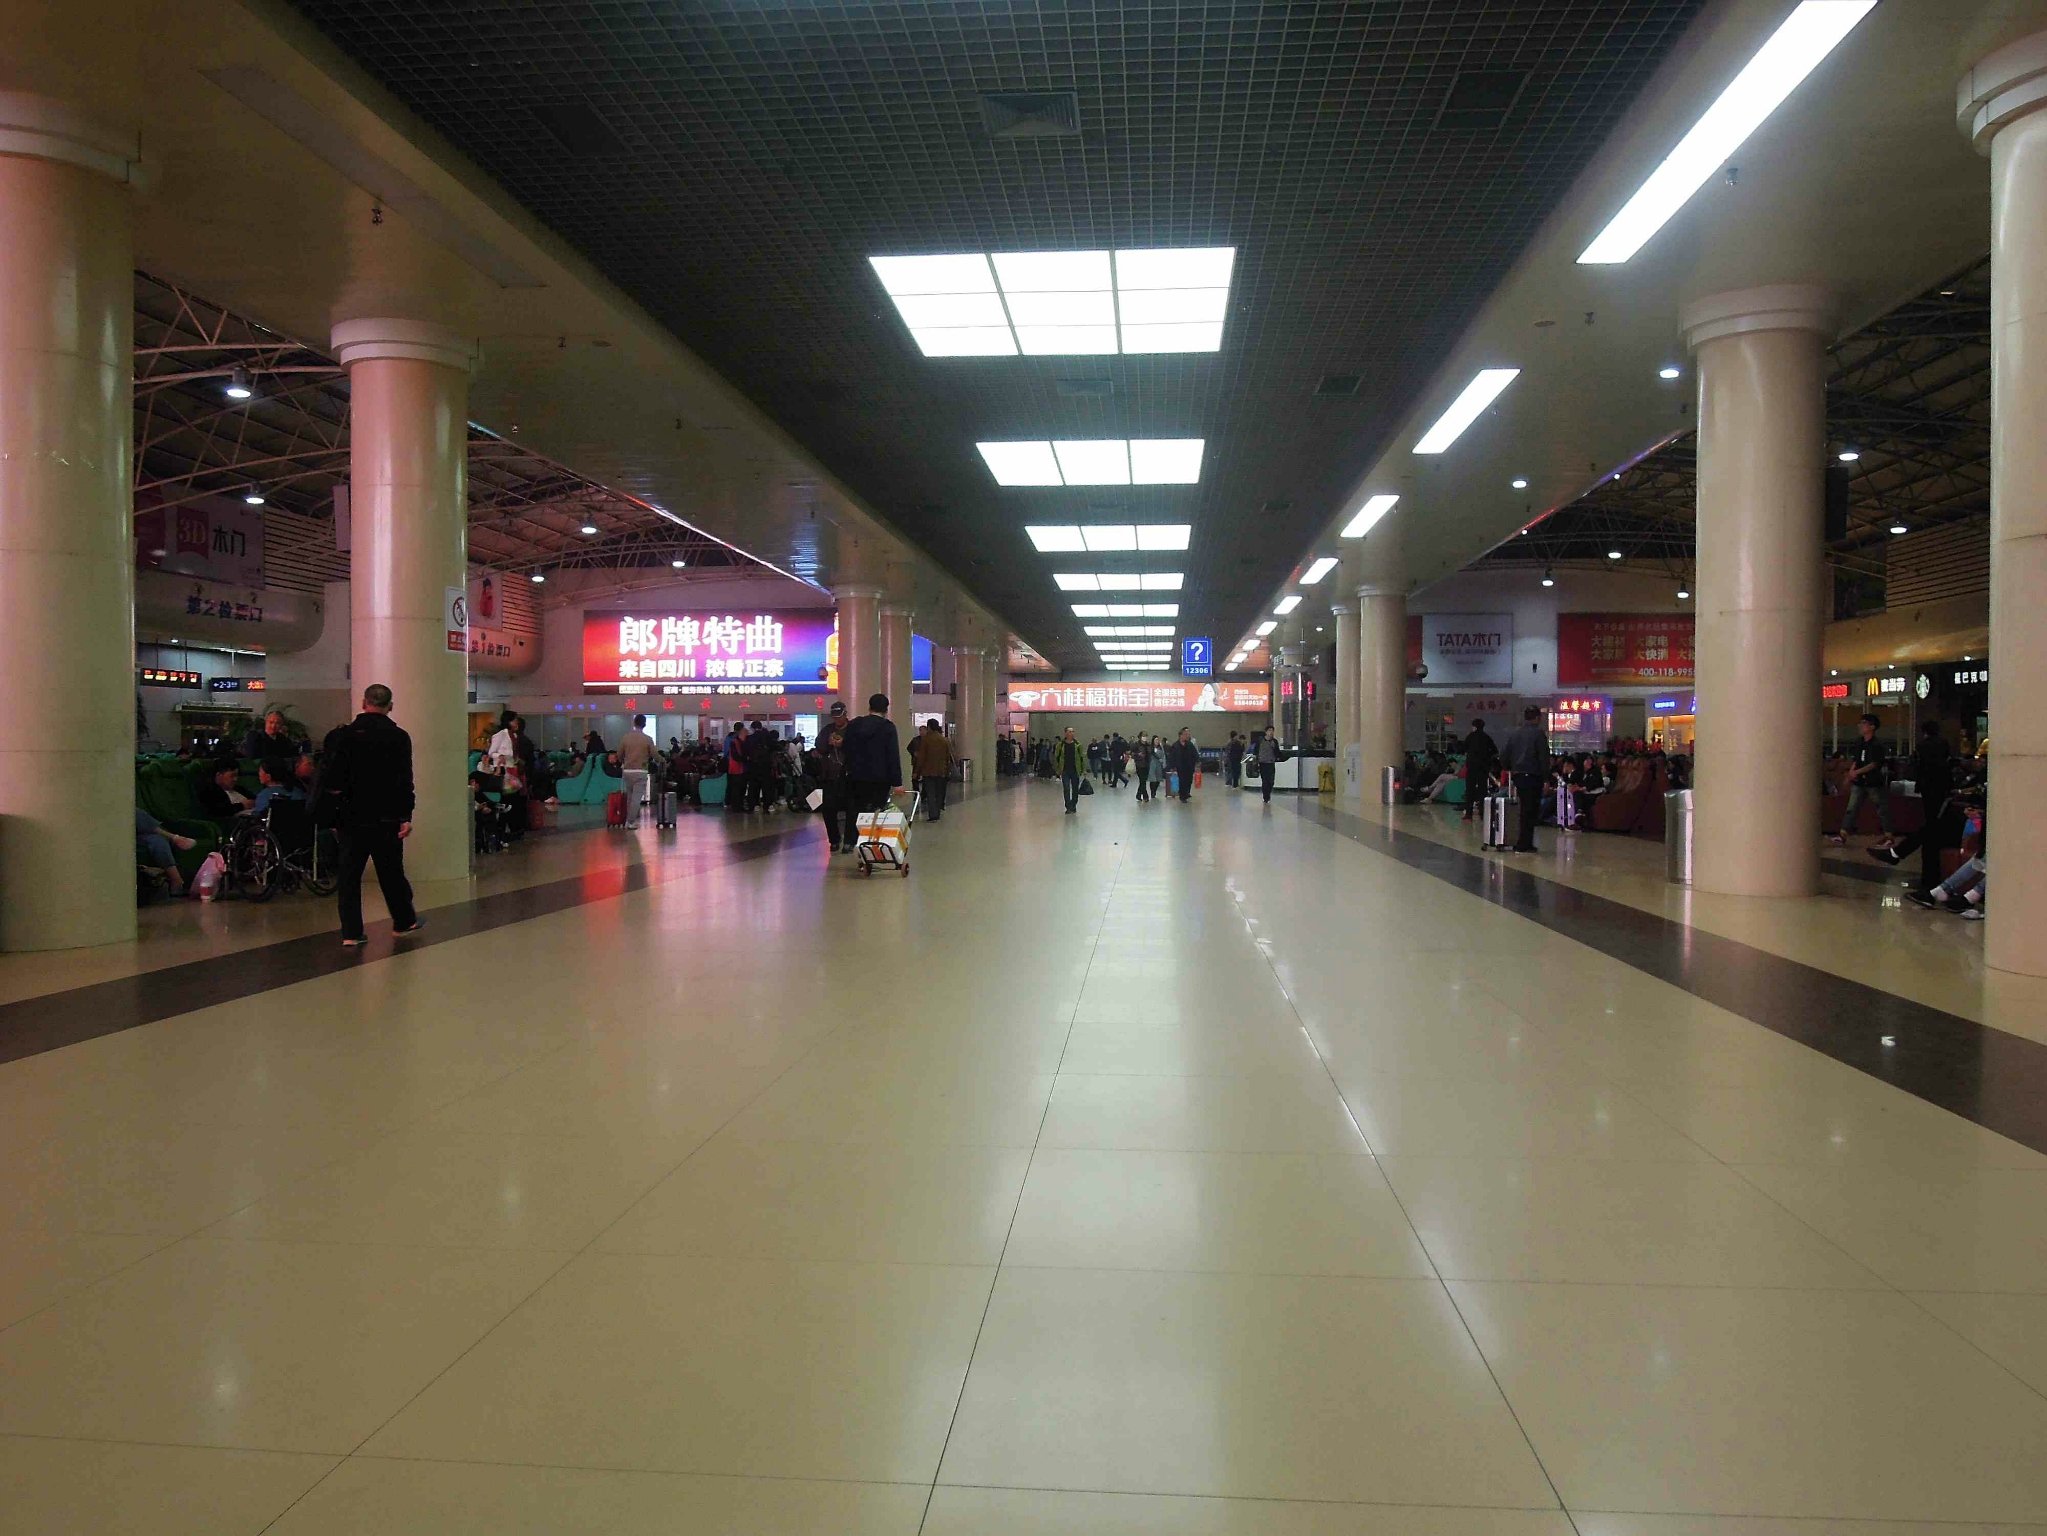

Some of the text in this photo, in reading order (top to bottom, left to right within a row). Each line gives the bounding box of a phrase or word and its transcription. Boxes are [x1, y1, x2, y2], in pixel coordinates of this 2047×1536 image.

[212, 524, 245, 557] 木门
[619, 614, 783, 656] 郎牌特曲
[1436, 633, 1501, 647] TATA木门
[619, 658, 784, 679] 来自四川 浓香正宗
[1880, 677, 1906, 693] 麦当劳
[1040, 687, 1149, 707] 六桂福珠宝
[1560, 699, 1602, 711] 温馨超市
